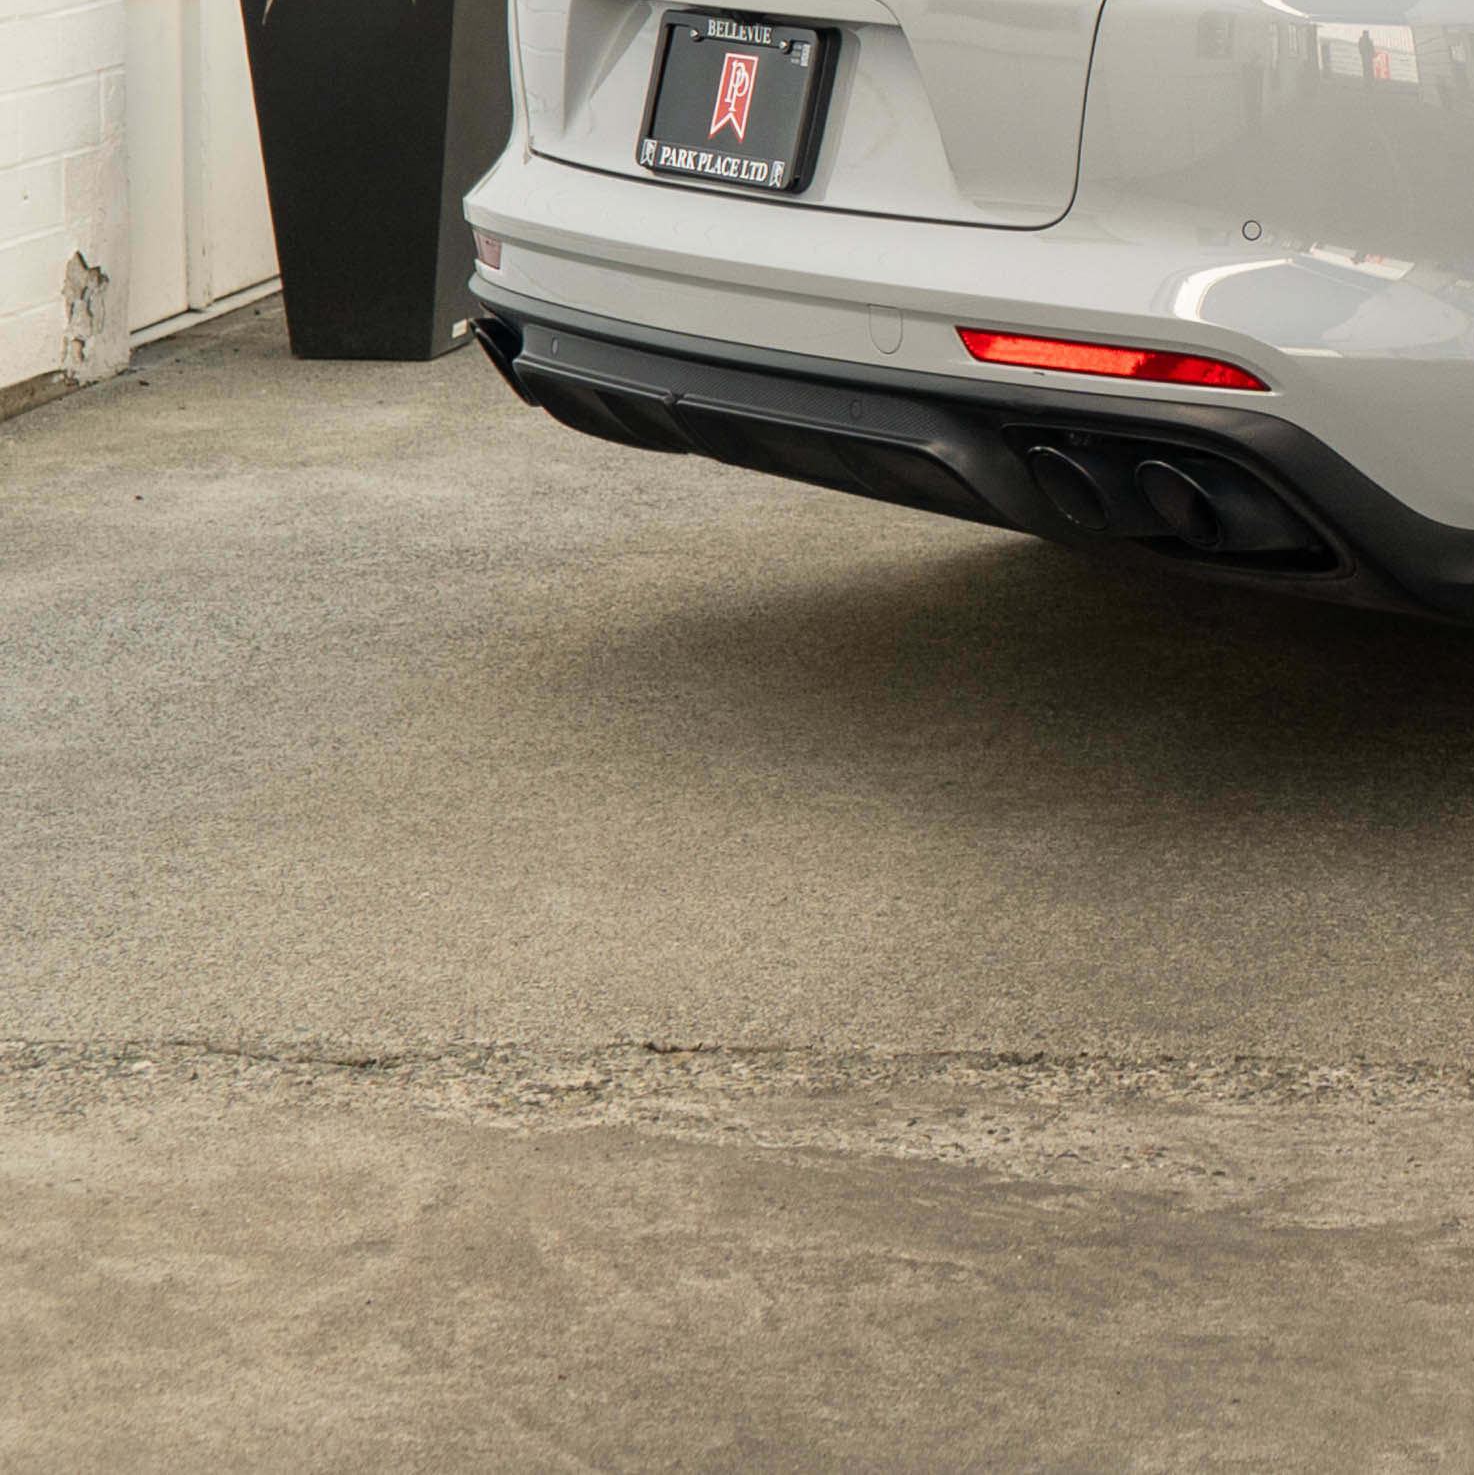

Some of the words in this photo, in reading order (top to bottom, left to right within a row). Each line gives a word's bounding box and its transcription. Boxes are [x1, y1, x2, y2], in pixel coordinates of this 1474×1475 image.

[707, 19, 772, 44] BELLEVUE
[659, 146, 697, 171] PARK
[697, 153, 739, 177] PLACE
[740, 160, 769, 182] LTD
